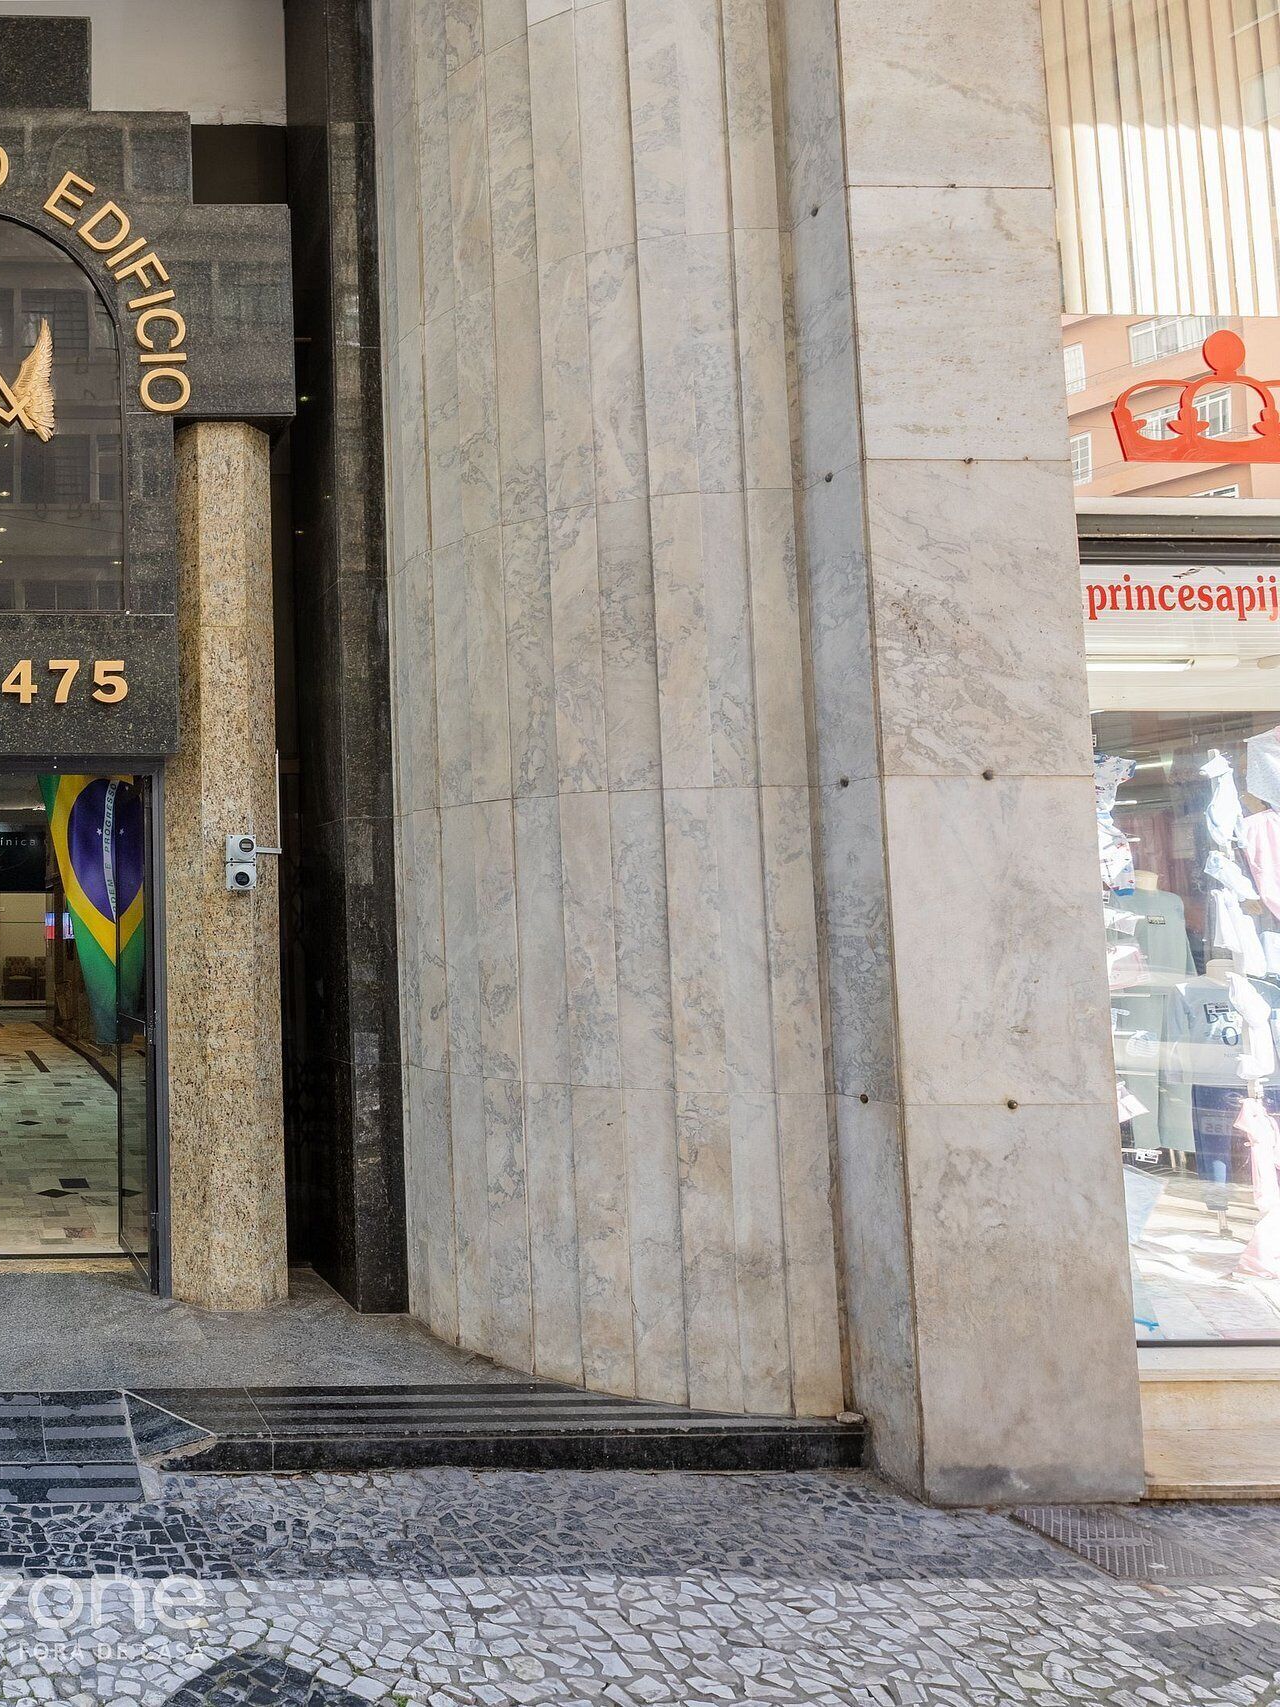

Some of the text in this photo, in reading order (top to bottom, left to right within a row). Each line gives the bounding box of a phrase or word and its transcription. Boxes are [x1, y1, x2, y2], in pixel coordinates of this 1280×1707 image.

[44, 171, 191, 413] EDIFICIO
[1, 659, 130, 704] 475
[104, 783, 117, 853] PROGRESSO
